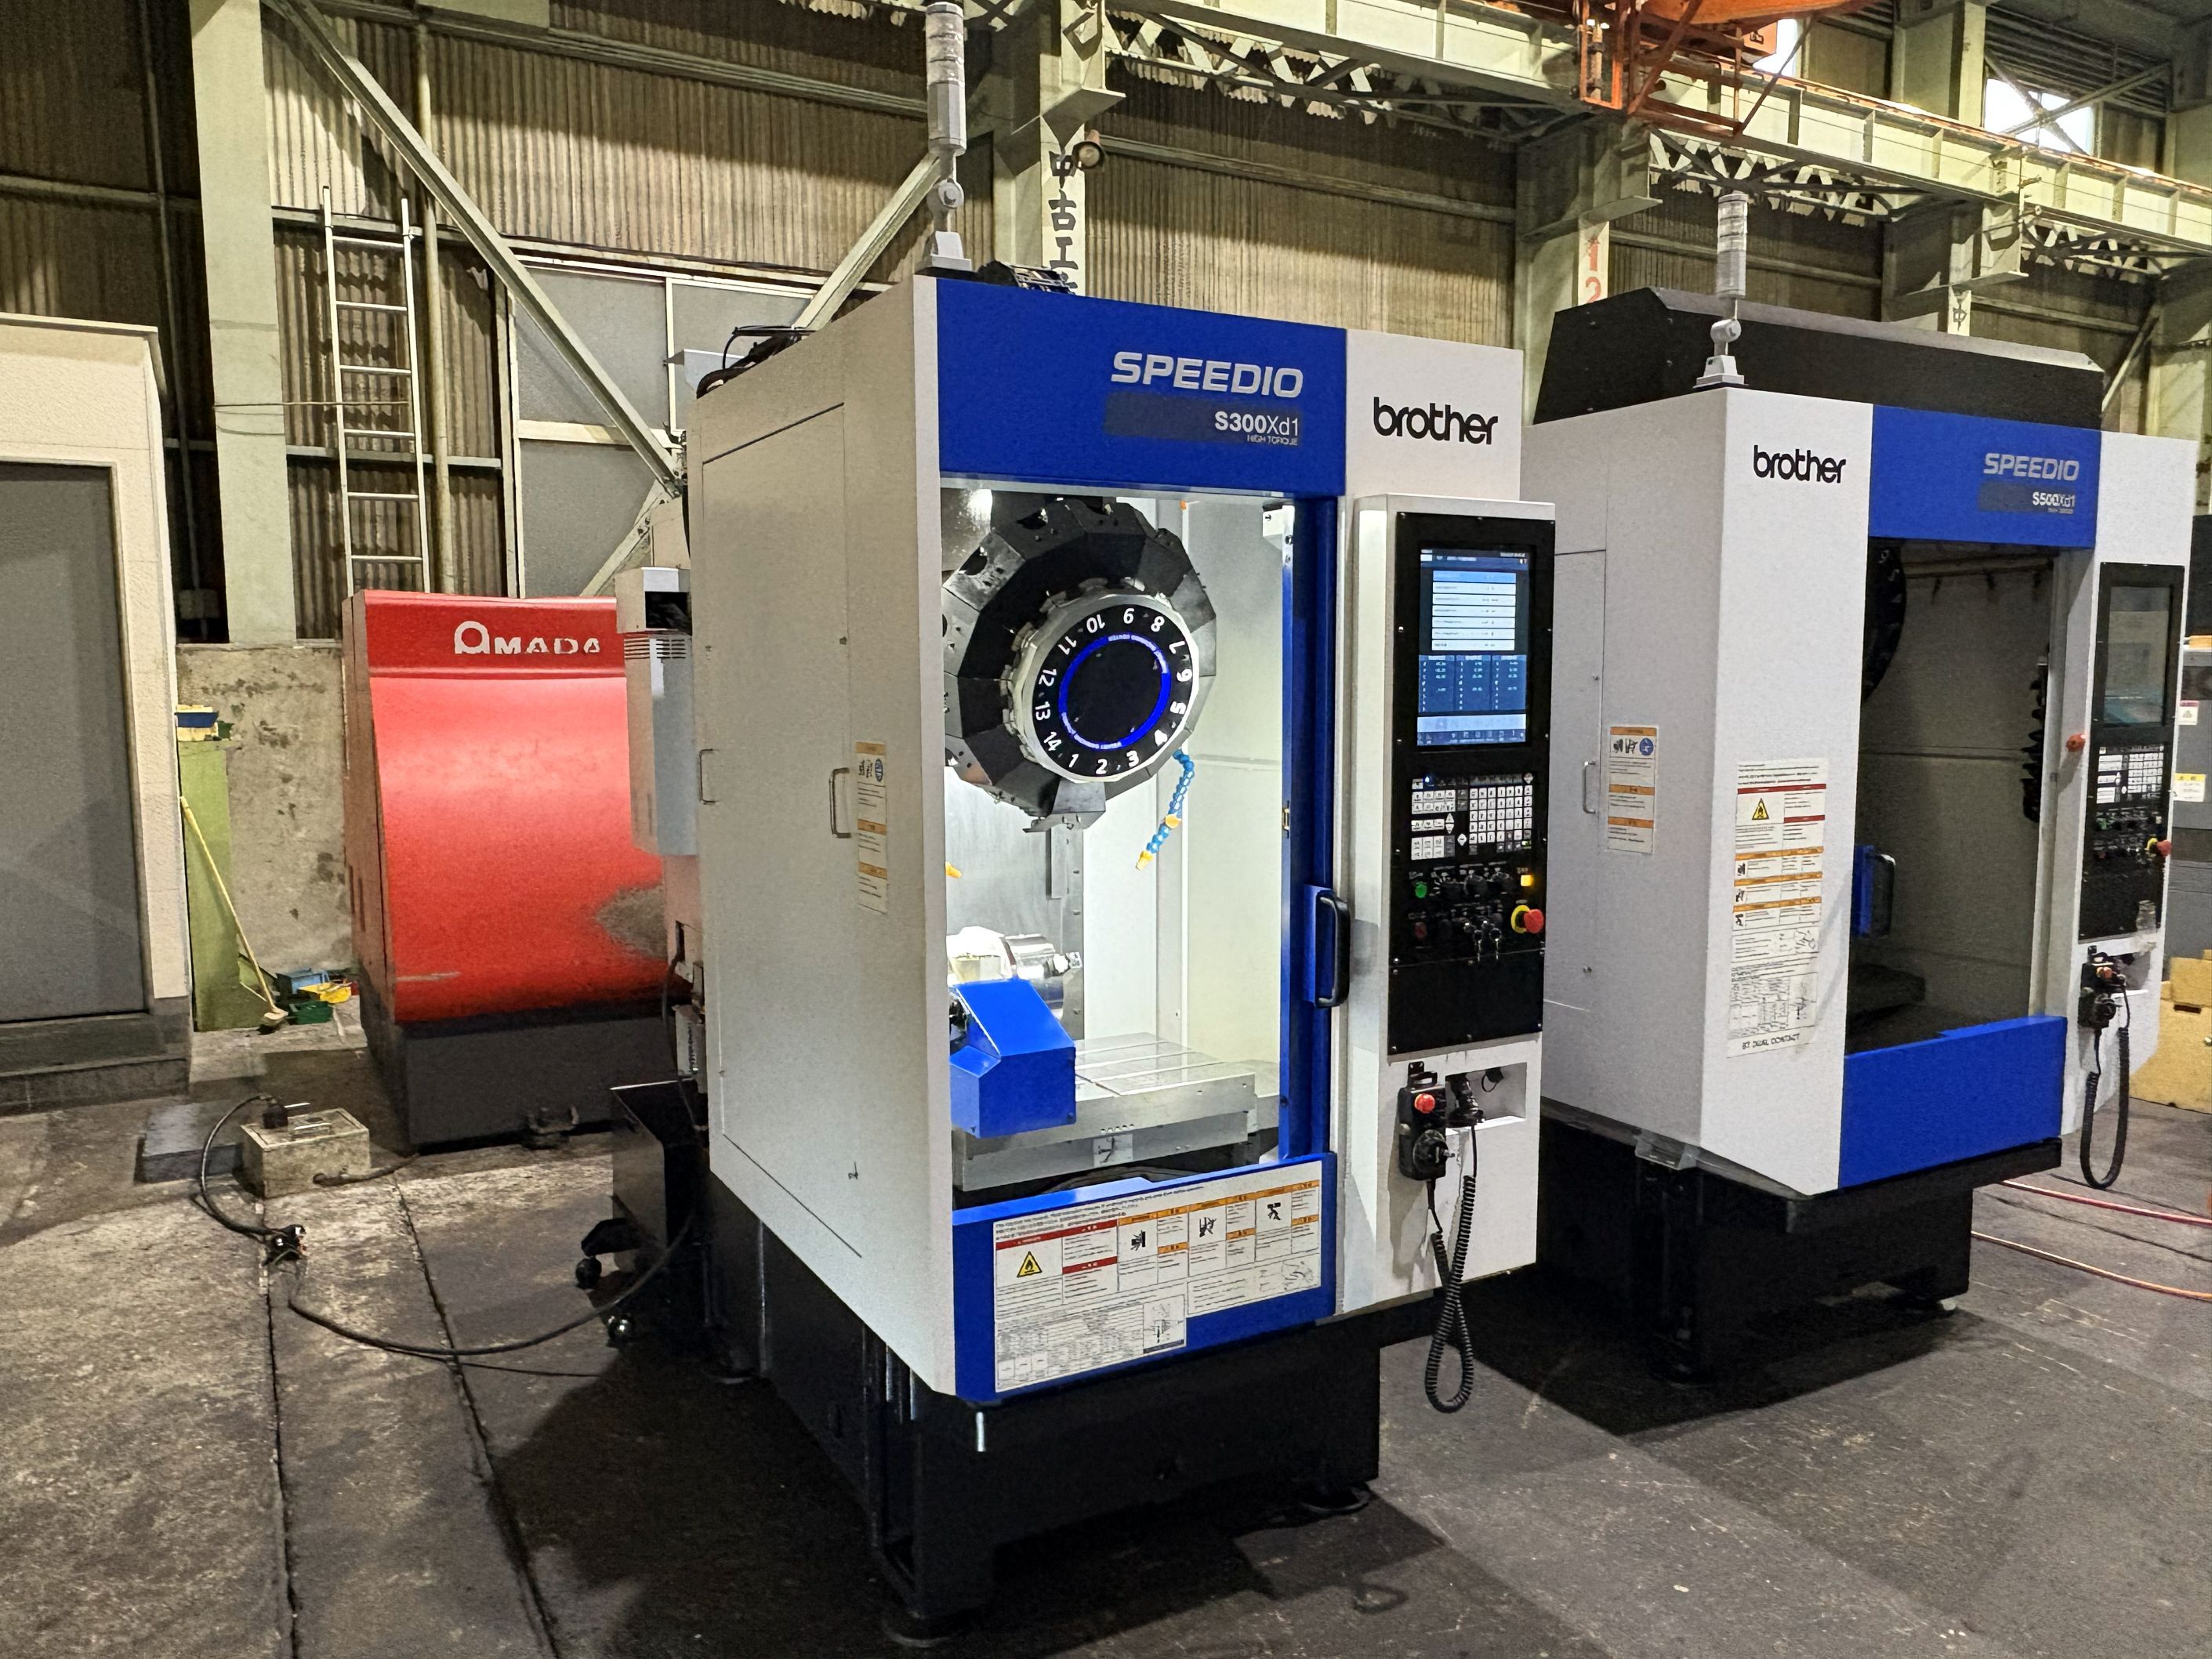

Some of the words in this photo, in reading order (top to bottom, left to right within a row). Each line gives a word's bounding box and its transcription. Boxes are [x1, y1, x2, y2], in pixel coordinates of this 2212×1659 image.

[1048, 149, 1079, 290] 中古工
[1111, 351, 1304, 398] SPEEDIO
[1214, 411, 1299, 436] S300Xd1
[1373, 396, 1499, 445] brother
[1753, 444, 1847, 484] brother
[1983, 452, 2080, 481] SPEEDIO
[1086, 614, 1106, 633] 10
[1151, 616, 1165, 632] 8
[454, 620, 600, 654] AMADA
[1058, 636, 1077, 655] 11
[1039, 668, 1057, 686] 12
[1035, 701, 1051, 721] 13
[1169, 701, 1187, 715] 5
[1043, 732, 1062, 752] 14
[1068, 754, 1079, 768] 1
[1096, 759, 1108, 774] 2
[1126, 750, 1139, 767] 3
